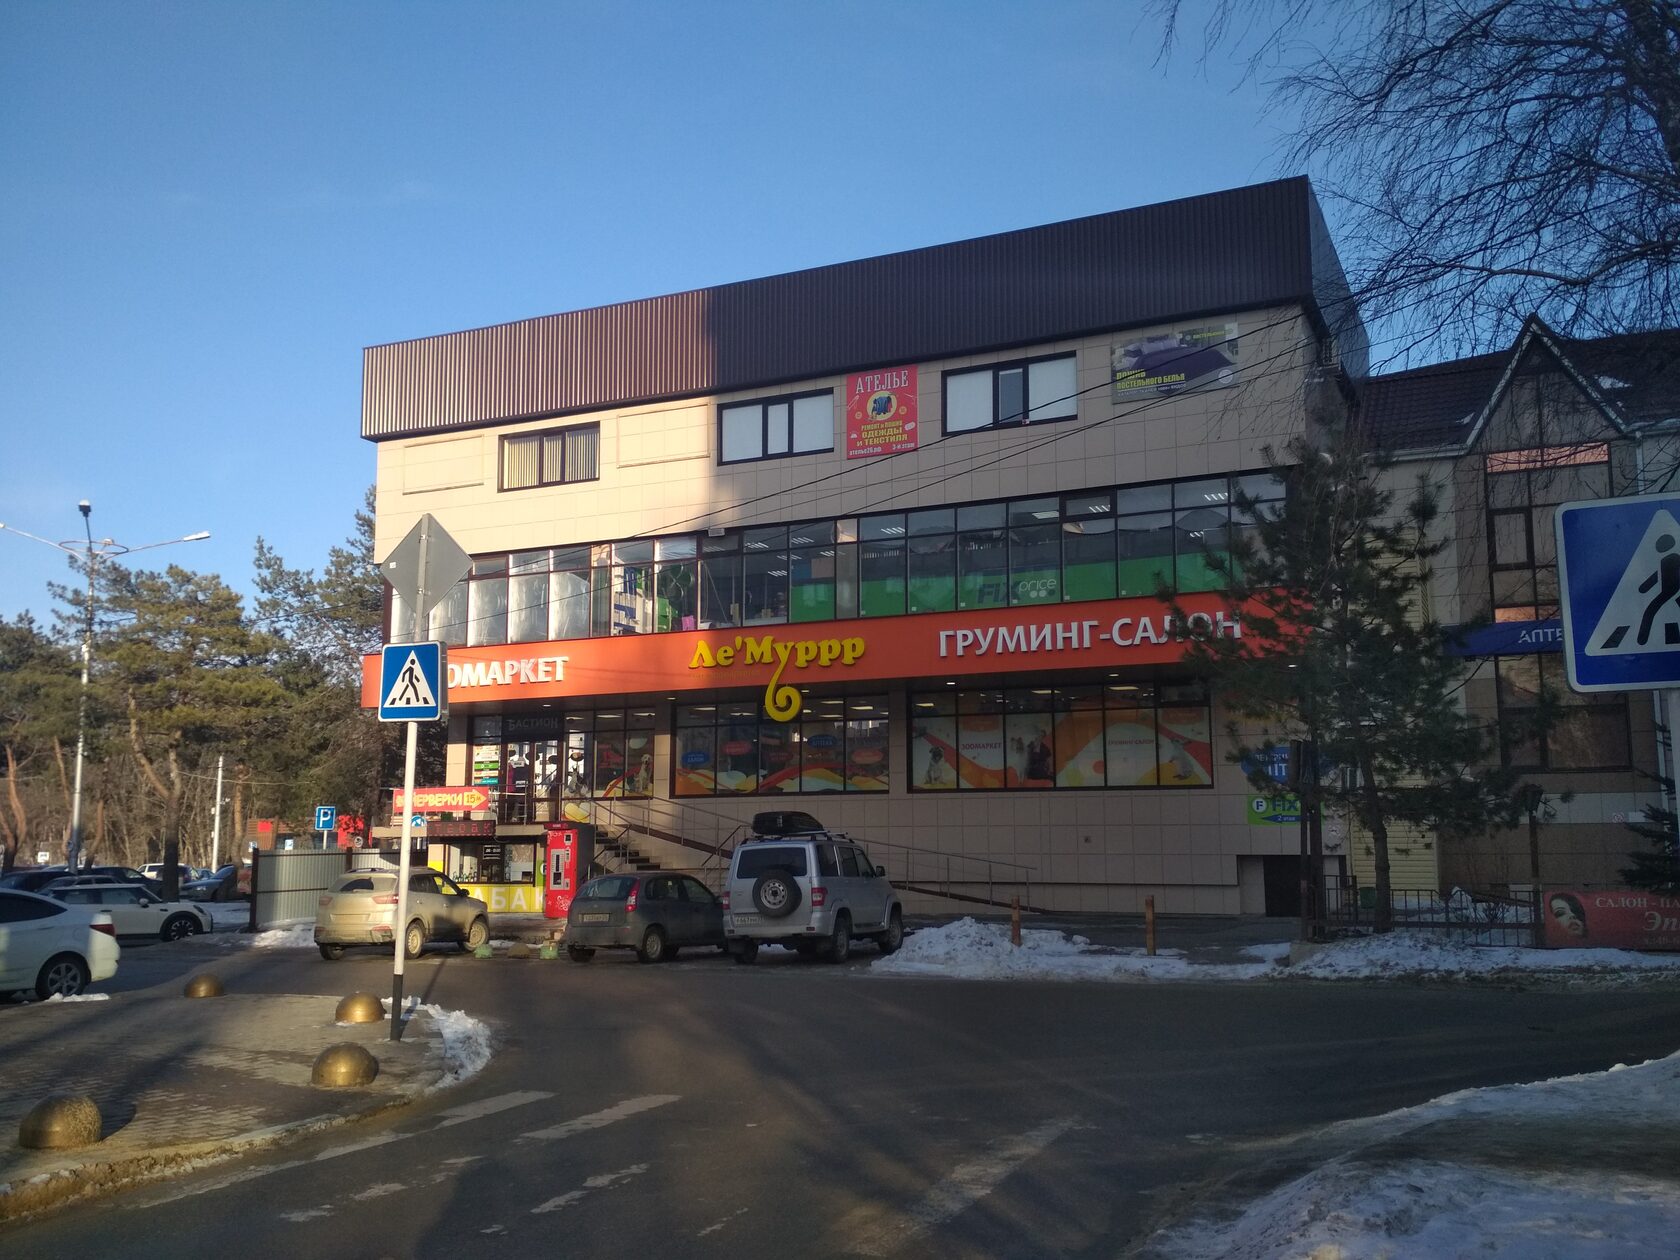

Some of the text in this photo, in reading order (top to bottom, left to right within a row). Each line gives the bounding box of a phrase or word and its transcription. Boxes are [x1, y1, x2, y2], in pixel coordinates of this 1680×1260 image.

[856, 370, 909, 394] АТЕЛЬЕ
[1116, 376, 1163, 389] ПОСТЕЛЬНОГО
[1163, 373, 1185, 383] БЕЛЬЯ
[861, 427, 902, 439] ОДЕЖДЫ
[864, 433, 908, 446] ТЕКСТИЛЯ
[1018, 578, 1057, 593] price
[505, 717, 558, 731] БАСТИОН
[1595, 896, 1648, 908] САЛОН
[1642, 911, 1680, 931] Эп
